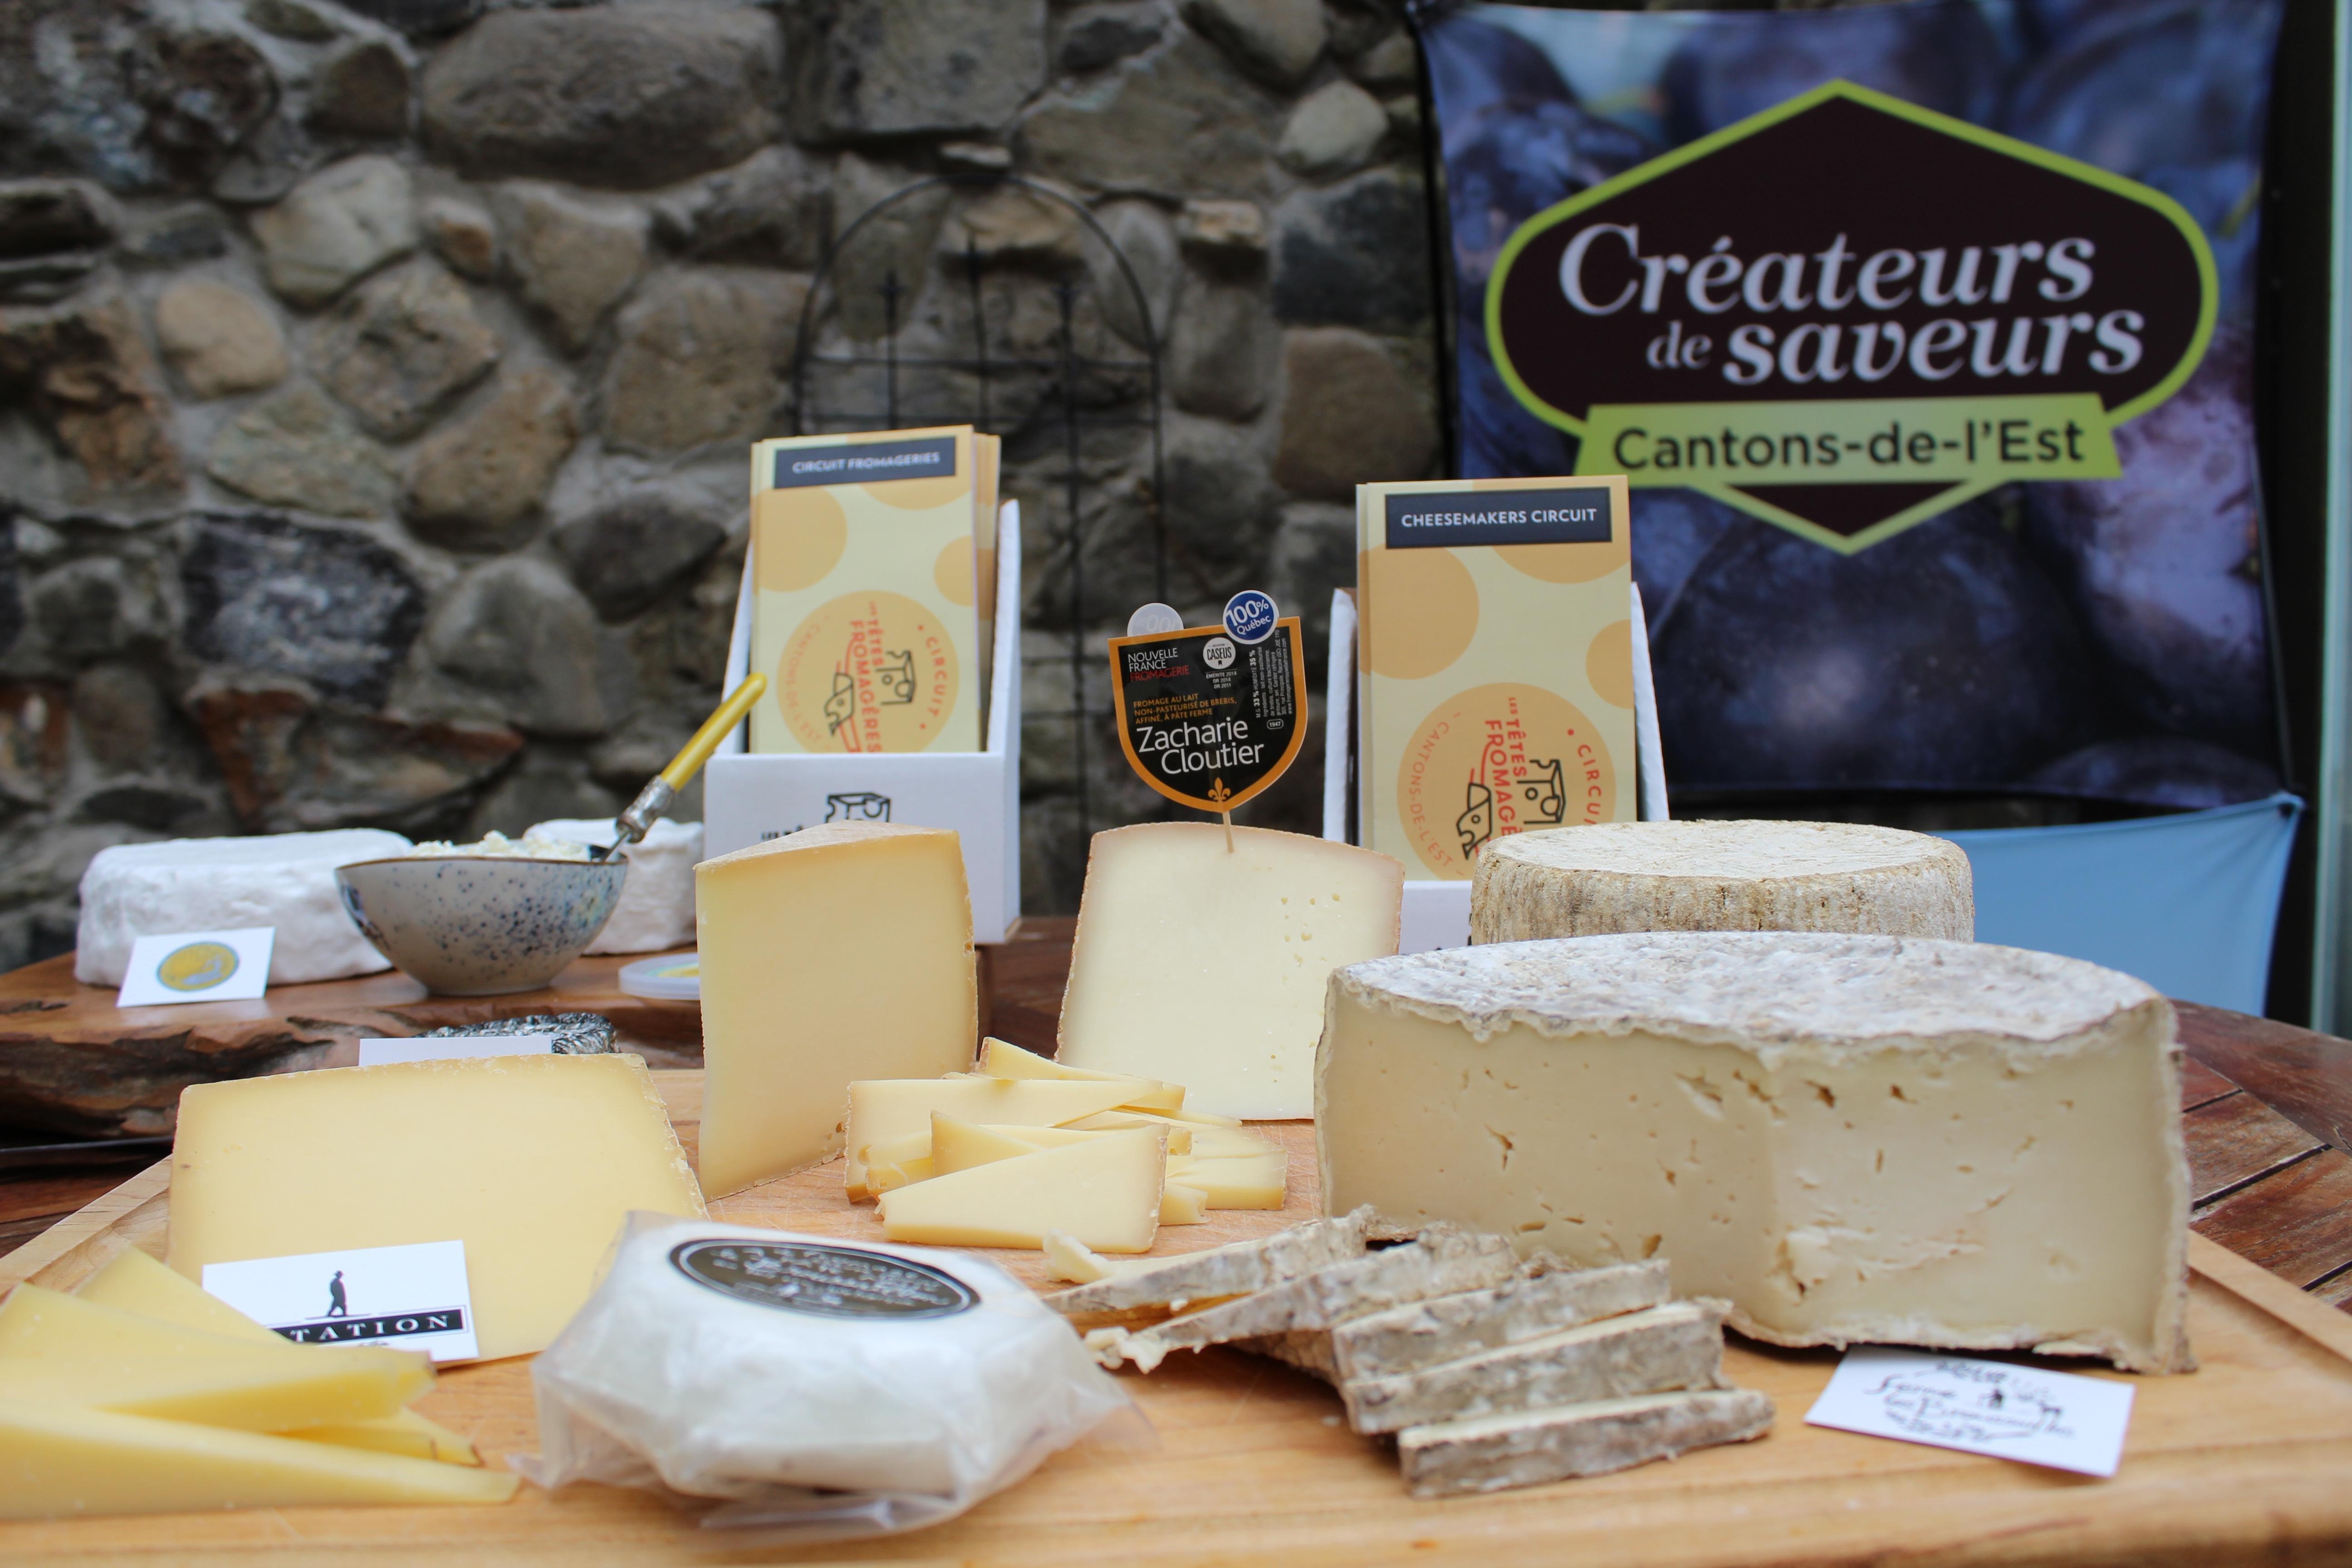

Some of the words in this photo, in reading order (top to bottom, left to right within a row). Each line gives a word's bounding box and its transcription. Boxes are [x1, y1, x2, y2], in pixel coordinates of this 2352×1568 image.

[1558, 221, 2097, 315] Créateurs
[1646, 320, 1712, 369] de
[1723, 308, 2145, 386] saveurs
[1613, 419, 2085, 471] Cantons-de-l'Est
[792, 458, 846, 474] CIRCUIT
[848, 451, 941, 470] FROMAGERIES
[1401, 510, 1527, 528] CHEESEMAKERS
[1531, 508, 1597, 524] CIRCUIT
[1226, 599, 1269, 626] 100%
[1237, 616, 1271, 635] Québec
[867, 620, 884, 666] TÊTES
[1207, 647, 1232, 660] CASEUS
[1128, 648, 1178, 663] NOUVELLE
[1129, 659, 1166, 672] FRANCE
[1250, 658, 1256, 666] 35
[926, 637, 948, 717] CIRCUIT
[1130, 665, 1190, 682] FROMAGERIE
[1133, 697, 1169, 708] FROMAGE
[1134, 701, 1198, 716] NON-PASTEURISÉ
[1211, 697, 1237, 706] BREBIS,
[1254, 698, 1260, 706] 33
[1509, 697, 1518, 715] LES
[1136, 714, 1163, 725] AFFINÉ,
[1171, 710, 1188, 720] PÂTE
[1190, 708, 1213, 717] FERME
[1136, 717, 1248, 753] Zacharie
[1161, 741, 1264, 774] Cloutier
[1506, 719, 1527, 777] TÊTES
[1485, 720, 1523, 836] FROMAGÈ
[1577, 744, 1602, 825] CIRCUI
[290, 1315, 449, 1343] TATION
